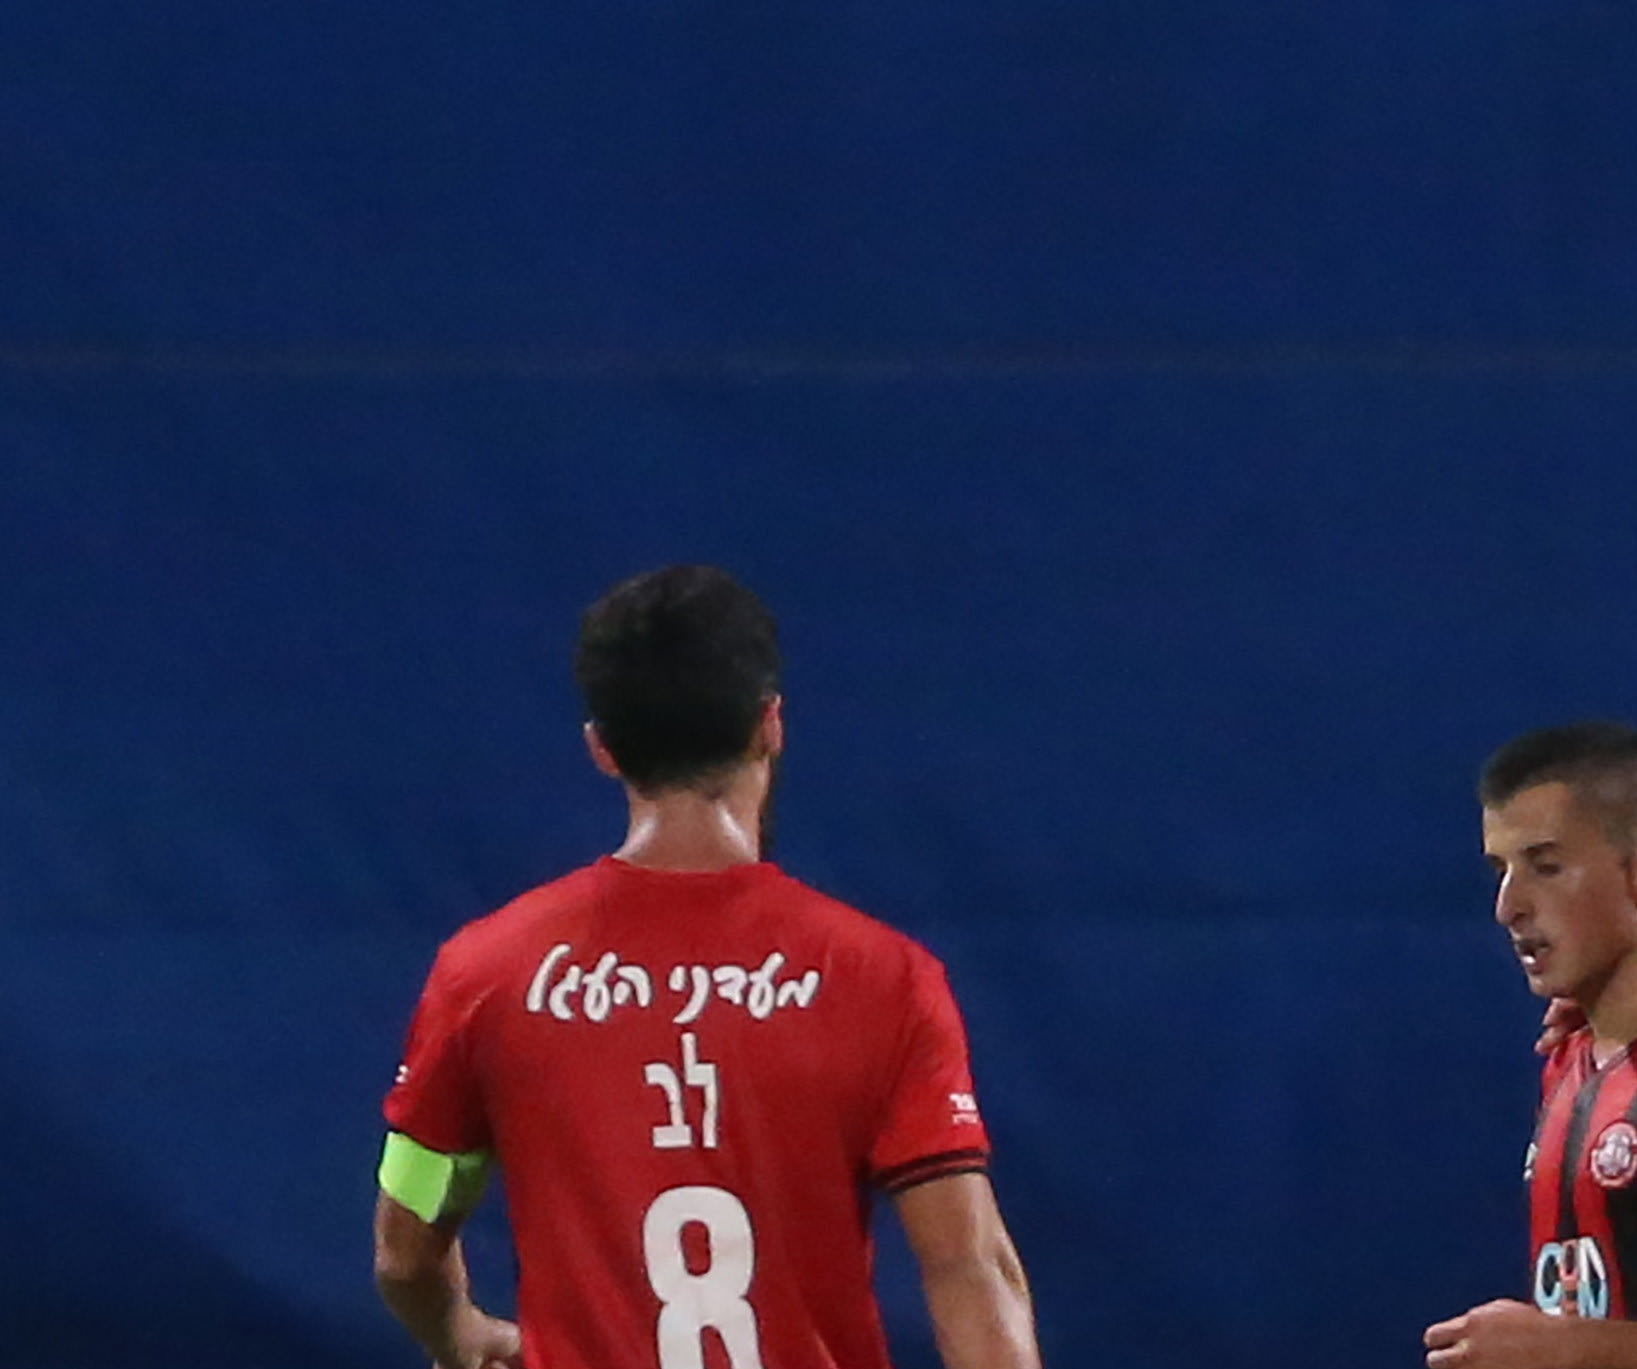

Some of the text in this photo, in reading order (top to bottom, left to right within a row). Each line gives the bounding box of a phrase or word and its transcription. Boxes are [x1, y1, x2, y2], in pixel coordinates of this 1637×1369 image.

[526, 943, 820, 1024] מעדני העגל
[644, 1032, 718, 1149] לב
